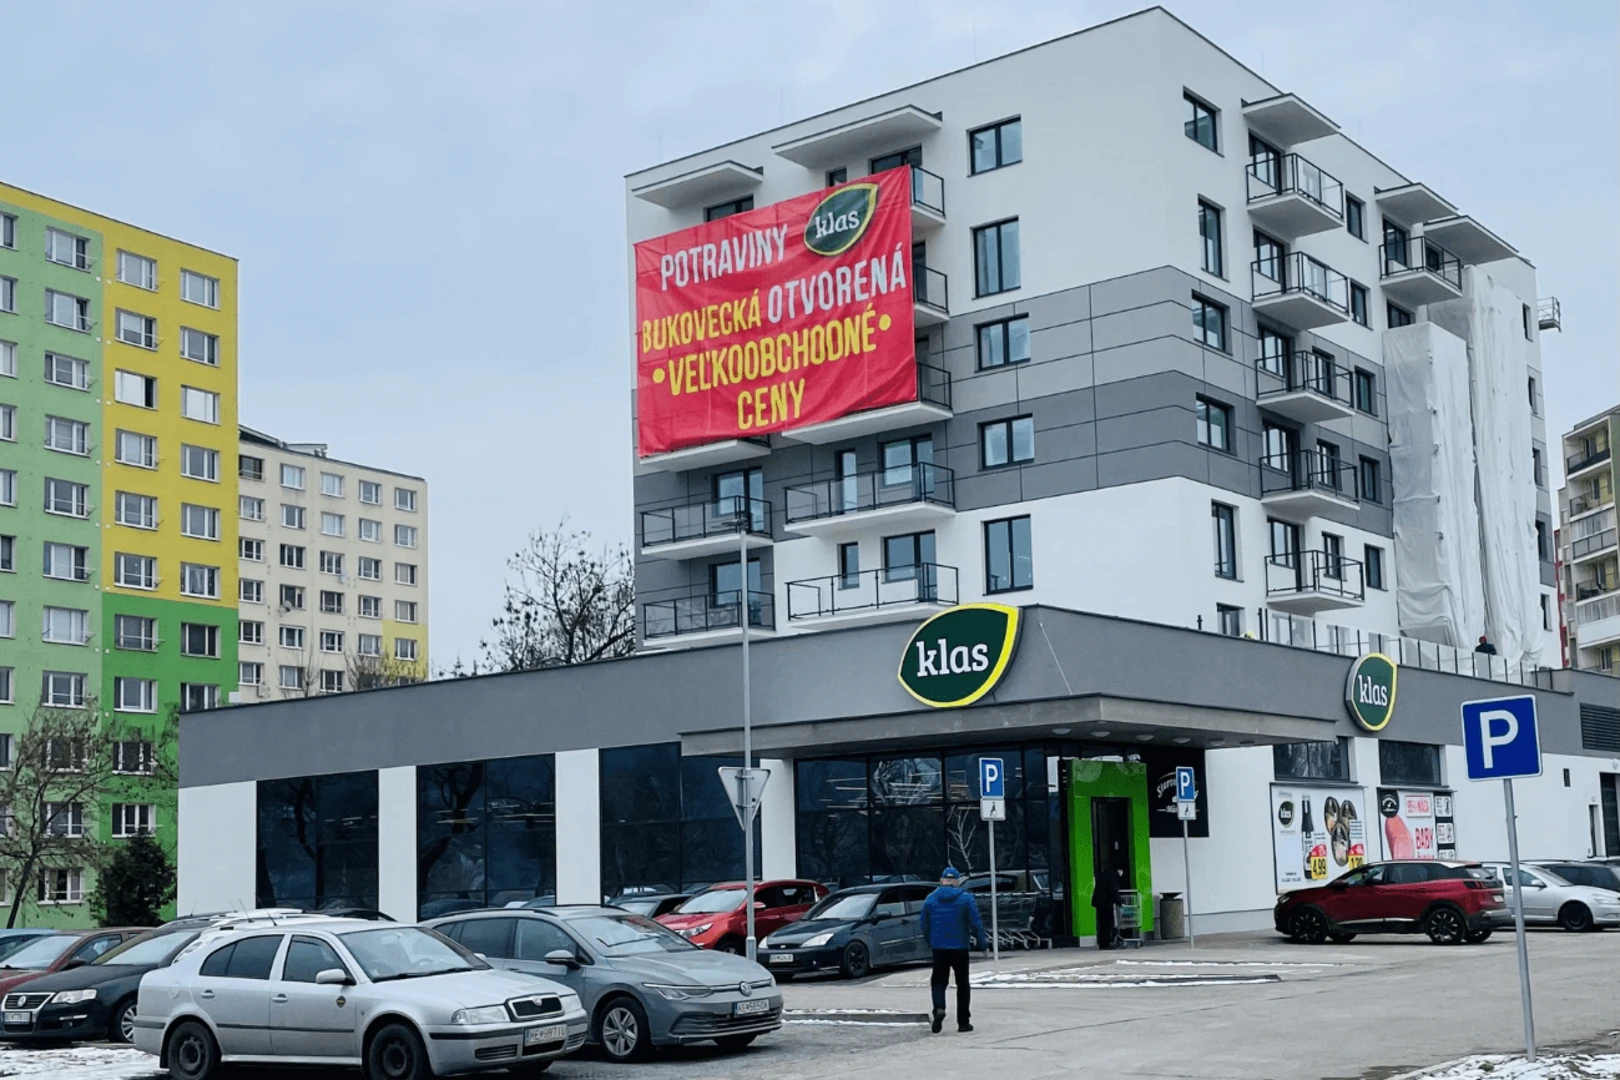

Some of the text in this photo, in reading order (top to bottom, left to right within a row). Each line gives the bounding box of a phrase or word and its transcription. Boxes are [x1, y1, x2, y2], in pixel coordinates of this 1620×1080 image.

[814, 209, 860, 238] klas
[661, 224, 787, 291] POTRAVINY
[642, 242, 906, 353] BUKOVECKÁ OTVORENÁ
[668, 302, 876, 396] VEĽKOOBCHODNÉ
[738, 378, 805, 430] CENY
[916, 638, 989, 677] klas
[1358, 674, 1388, 706] klas
[1480, 709, 1519, 769] P
[985, 764, 998, 792] P
[1180, 772, 1190, 796] P
[1415, 828, 1434, 849] BABY
